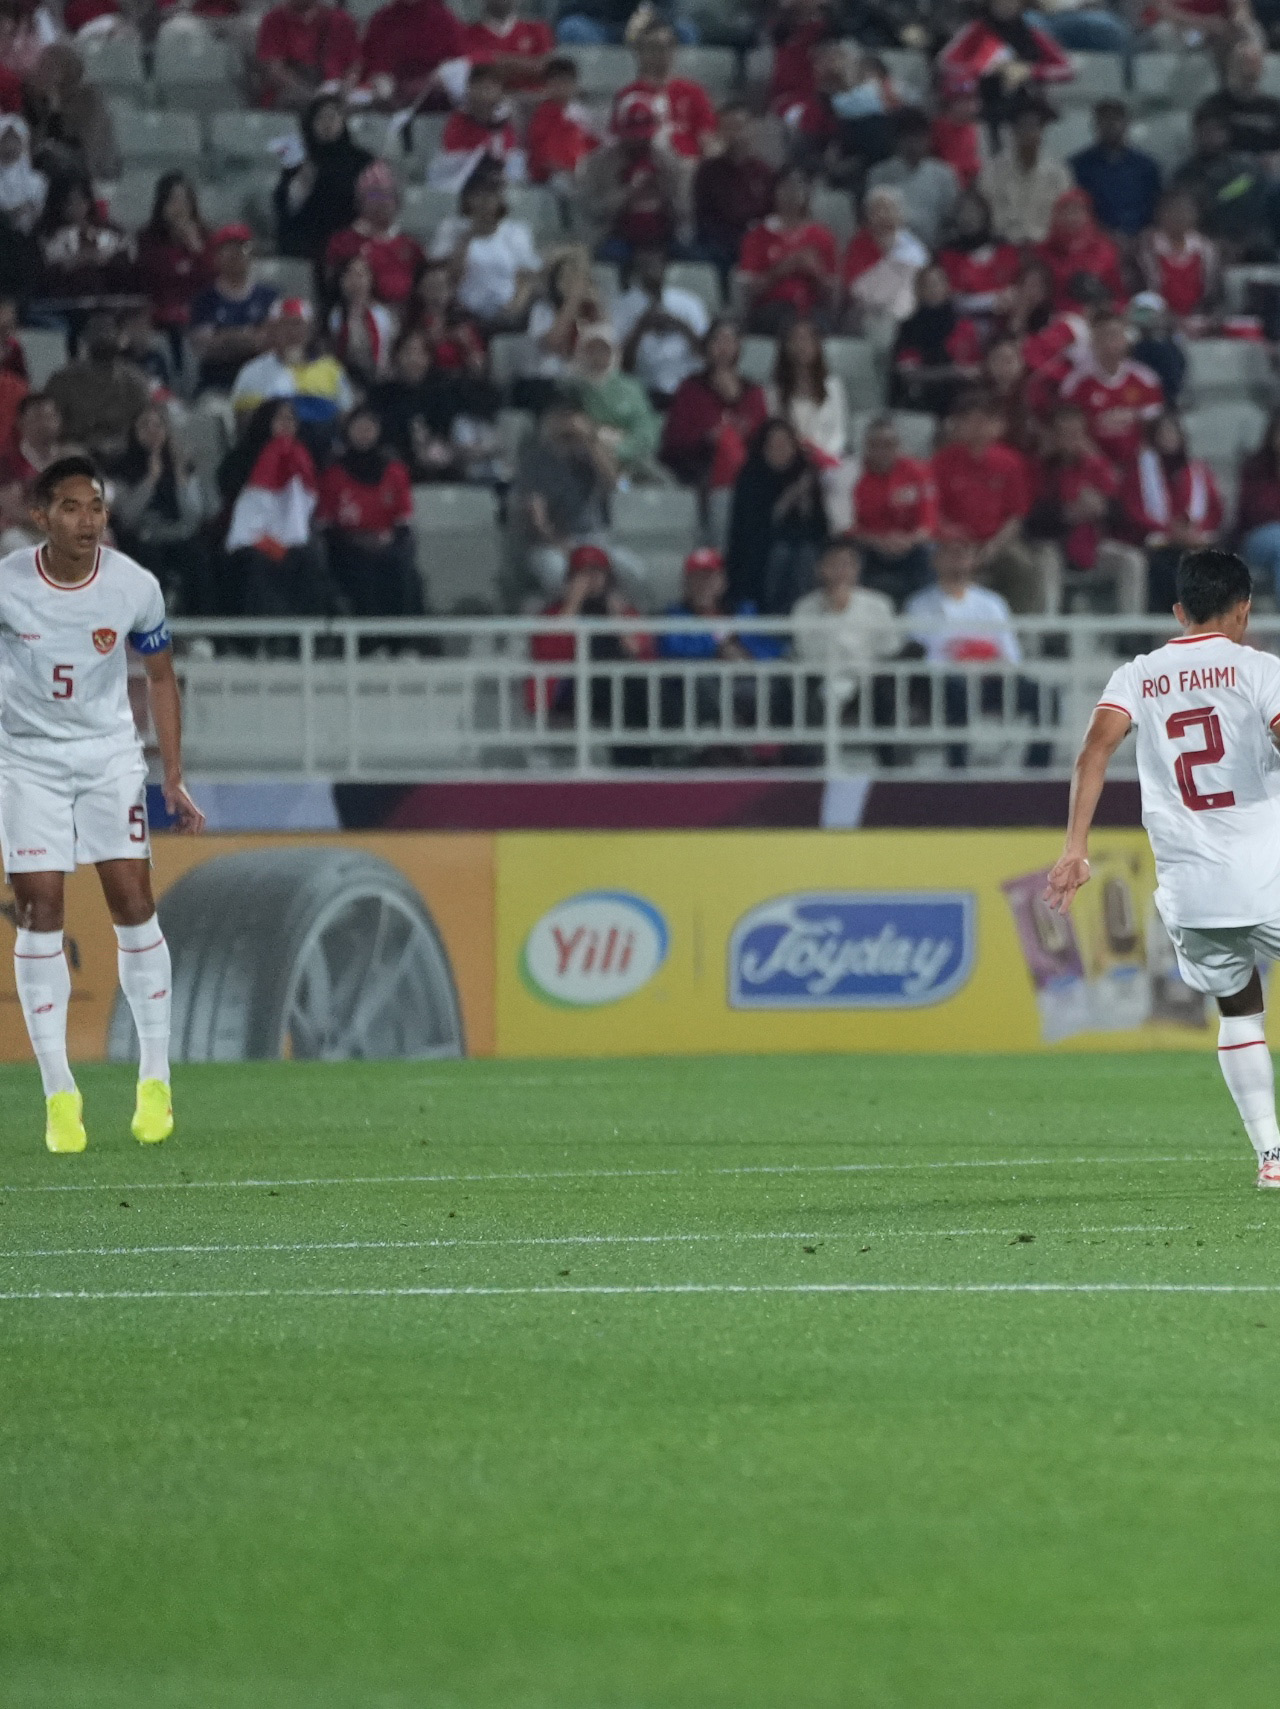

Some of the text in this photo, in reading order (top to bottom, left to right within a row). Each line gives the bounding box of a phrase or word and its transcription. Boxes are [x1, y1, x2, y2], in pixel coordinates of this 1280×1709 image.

[52, 663, 74, 700] 5
[1141, 665, 1237, 699] RIO FAHMI
[1165, 705, 1237, 812] 2
[128, 803, 146, 843] 5
[551, 925, 637, 977] Yili
[740, 916, 955, 997] Joyday
